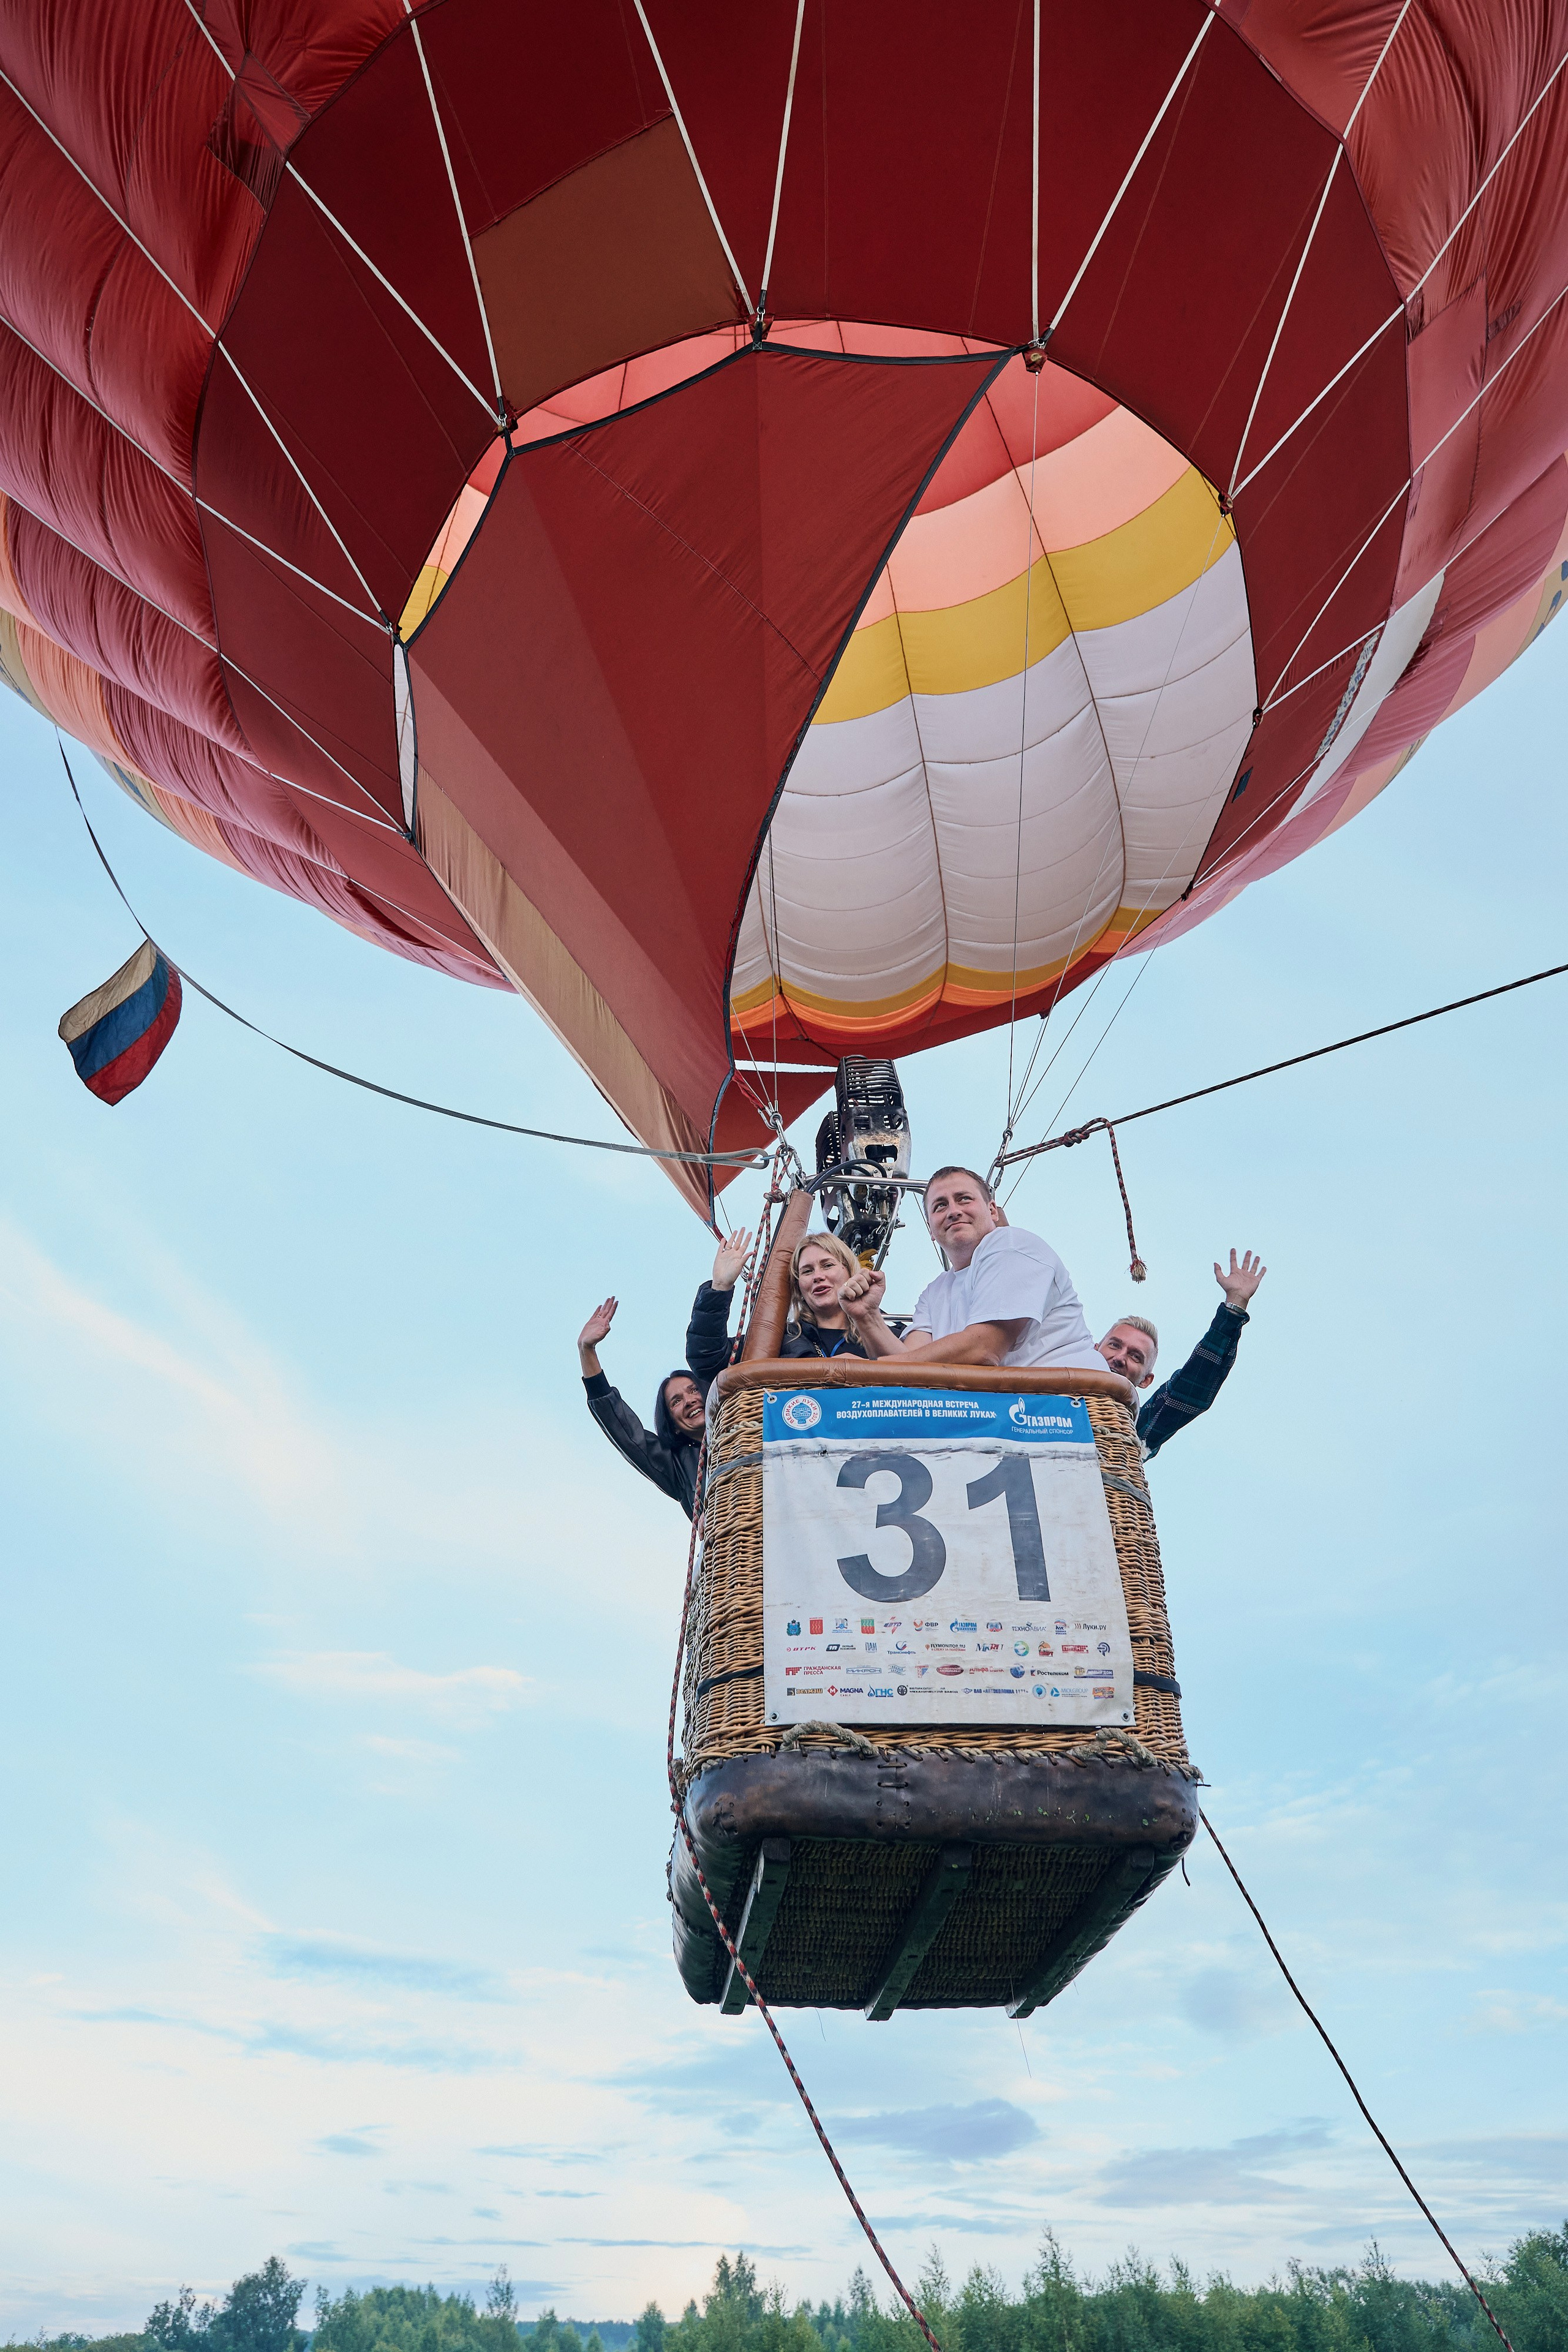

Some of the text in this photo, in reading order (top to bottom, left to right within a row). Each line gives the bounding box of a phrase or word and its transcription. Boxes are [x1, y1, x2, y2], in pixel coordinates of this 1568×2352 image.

[786, 1398, 818, 1423] ВЕЛИКИЕ ЛУКИ 2023
[872, 1400, 943, 1409] МЕЖДУНАРОДНАЯ
[945, 1400, 979, 1409] ВСТРЕЧА
[836, 1408, 922, 1419] ВОЗДУХОПЛАВАТЕЛЕЙ
[970, 1410, 997, 1419] ЛУКАХ
[1027, 1415, 1073, 1428] ГАЗПРОМ
[836, 1451, 1051, 1603] 31
